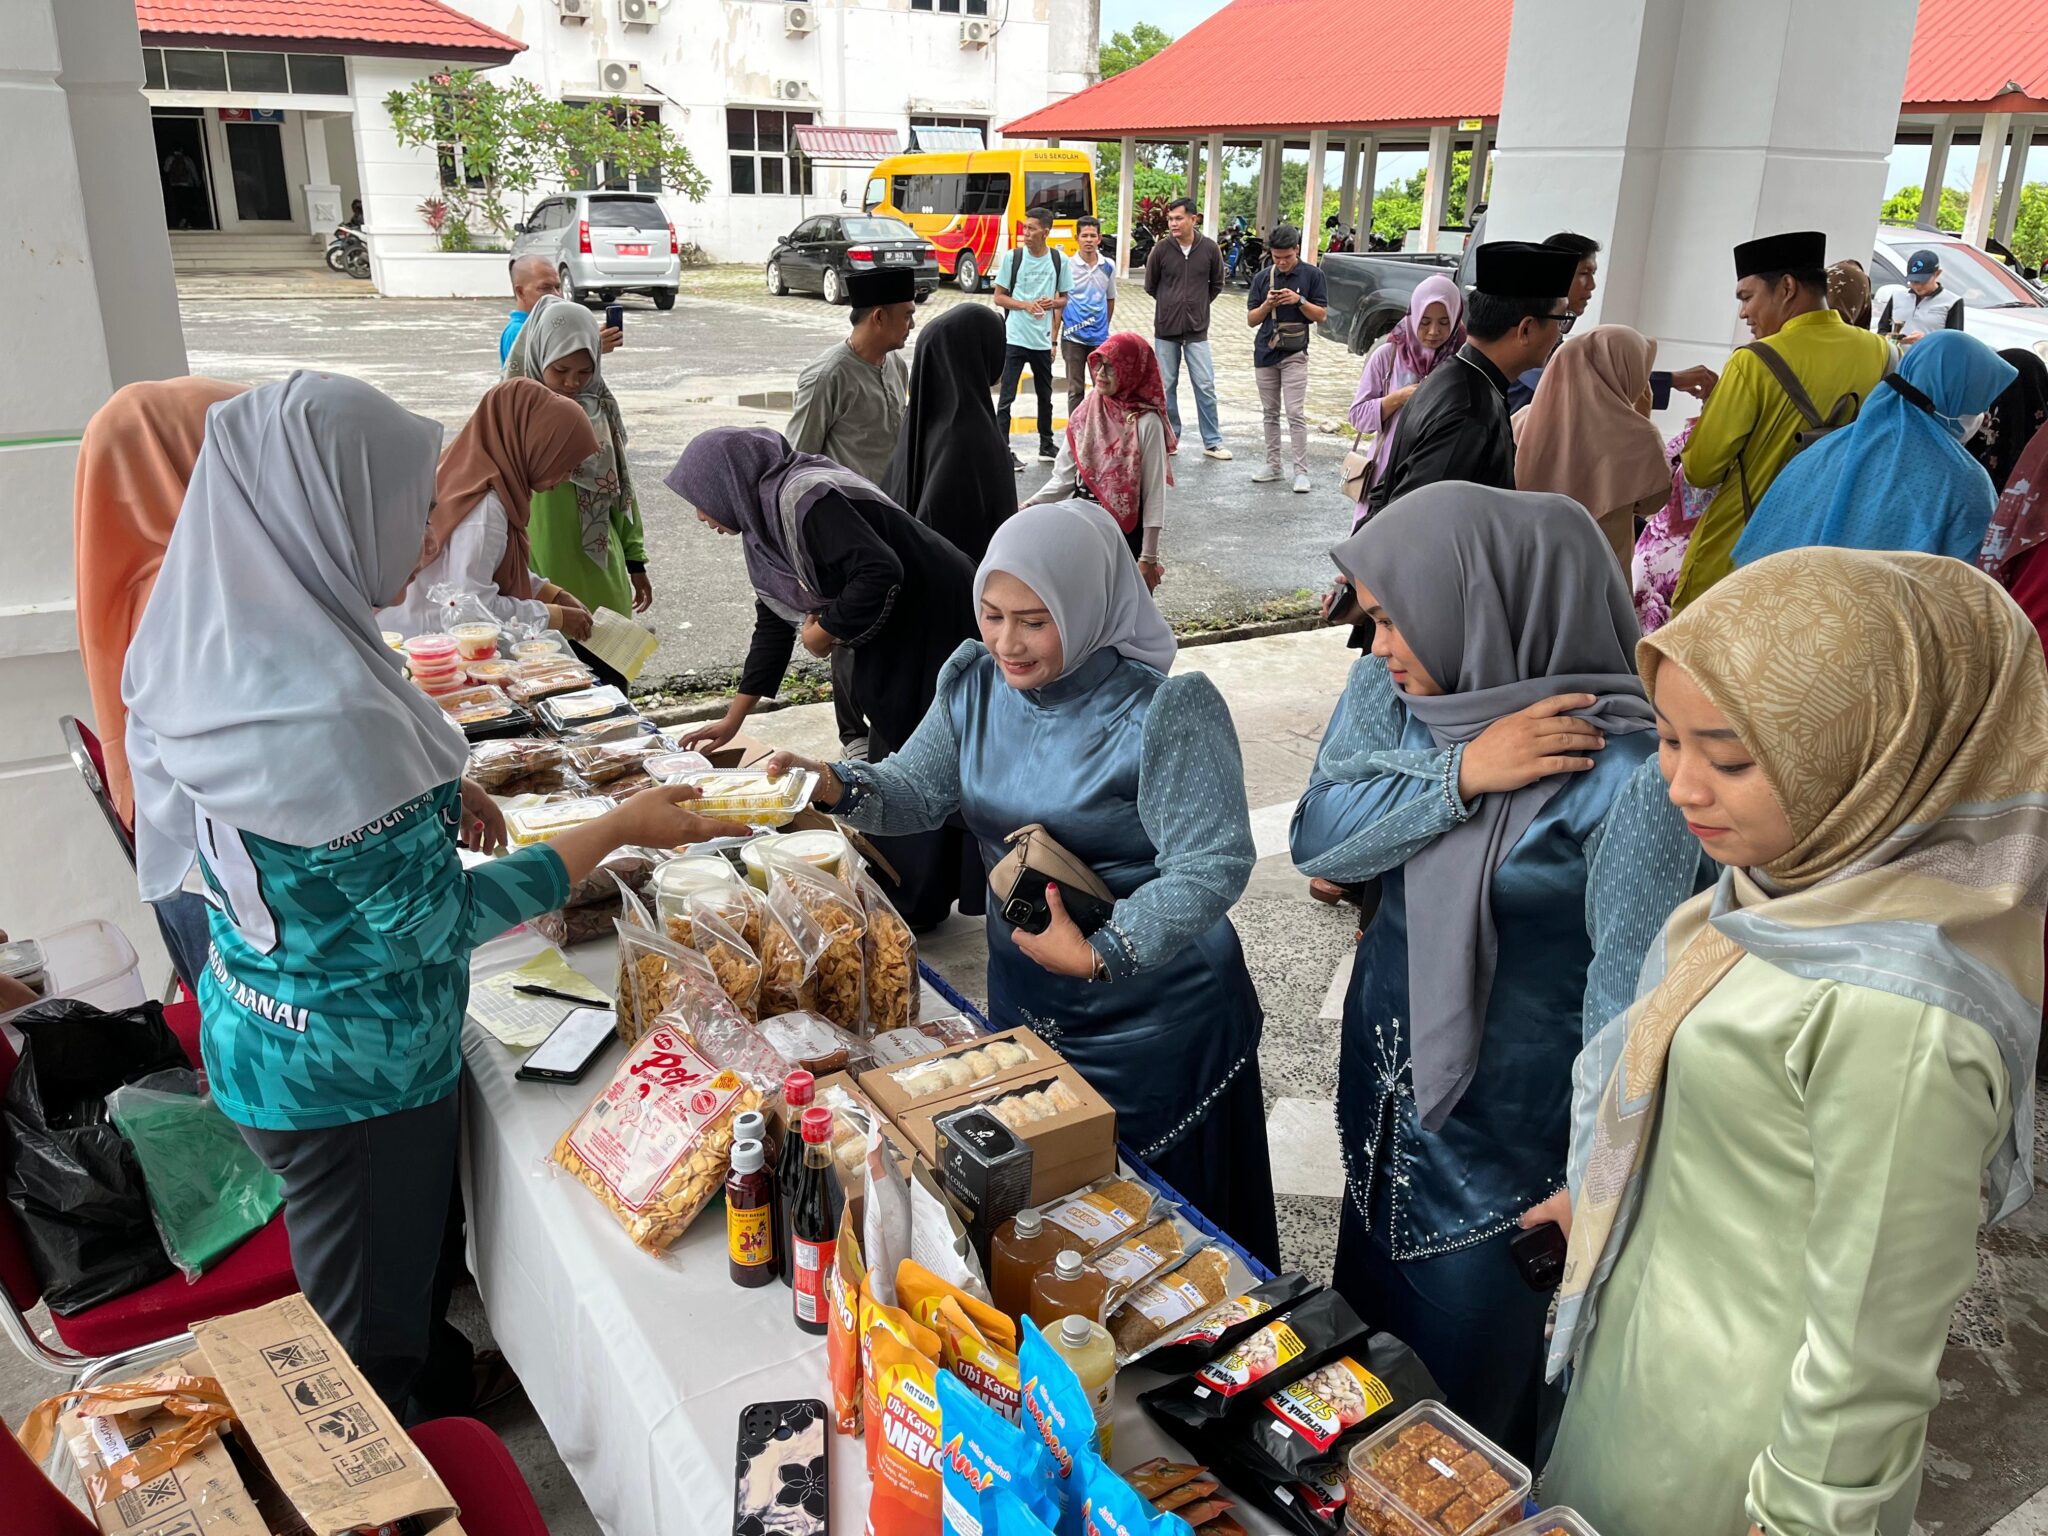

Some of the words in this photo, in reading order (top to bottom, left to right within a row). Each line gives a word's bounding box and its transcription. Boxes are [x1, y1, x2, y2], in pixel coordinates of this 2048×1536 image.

[950, 1173, 981, 1205] COLORING
[959, 1362, 980, 1383] Ubi
[983, 1375, 1018, 1402] Kayu
[887, 1396, 905, 1417] Ubi
[906, 1410, 935, 1440] Kayu
[1287, 1403, 1329, 1441] Kerupuk
